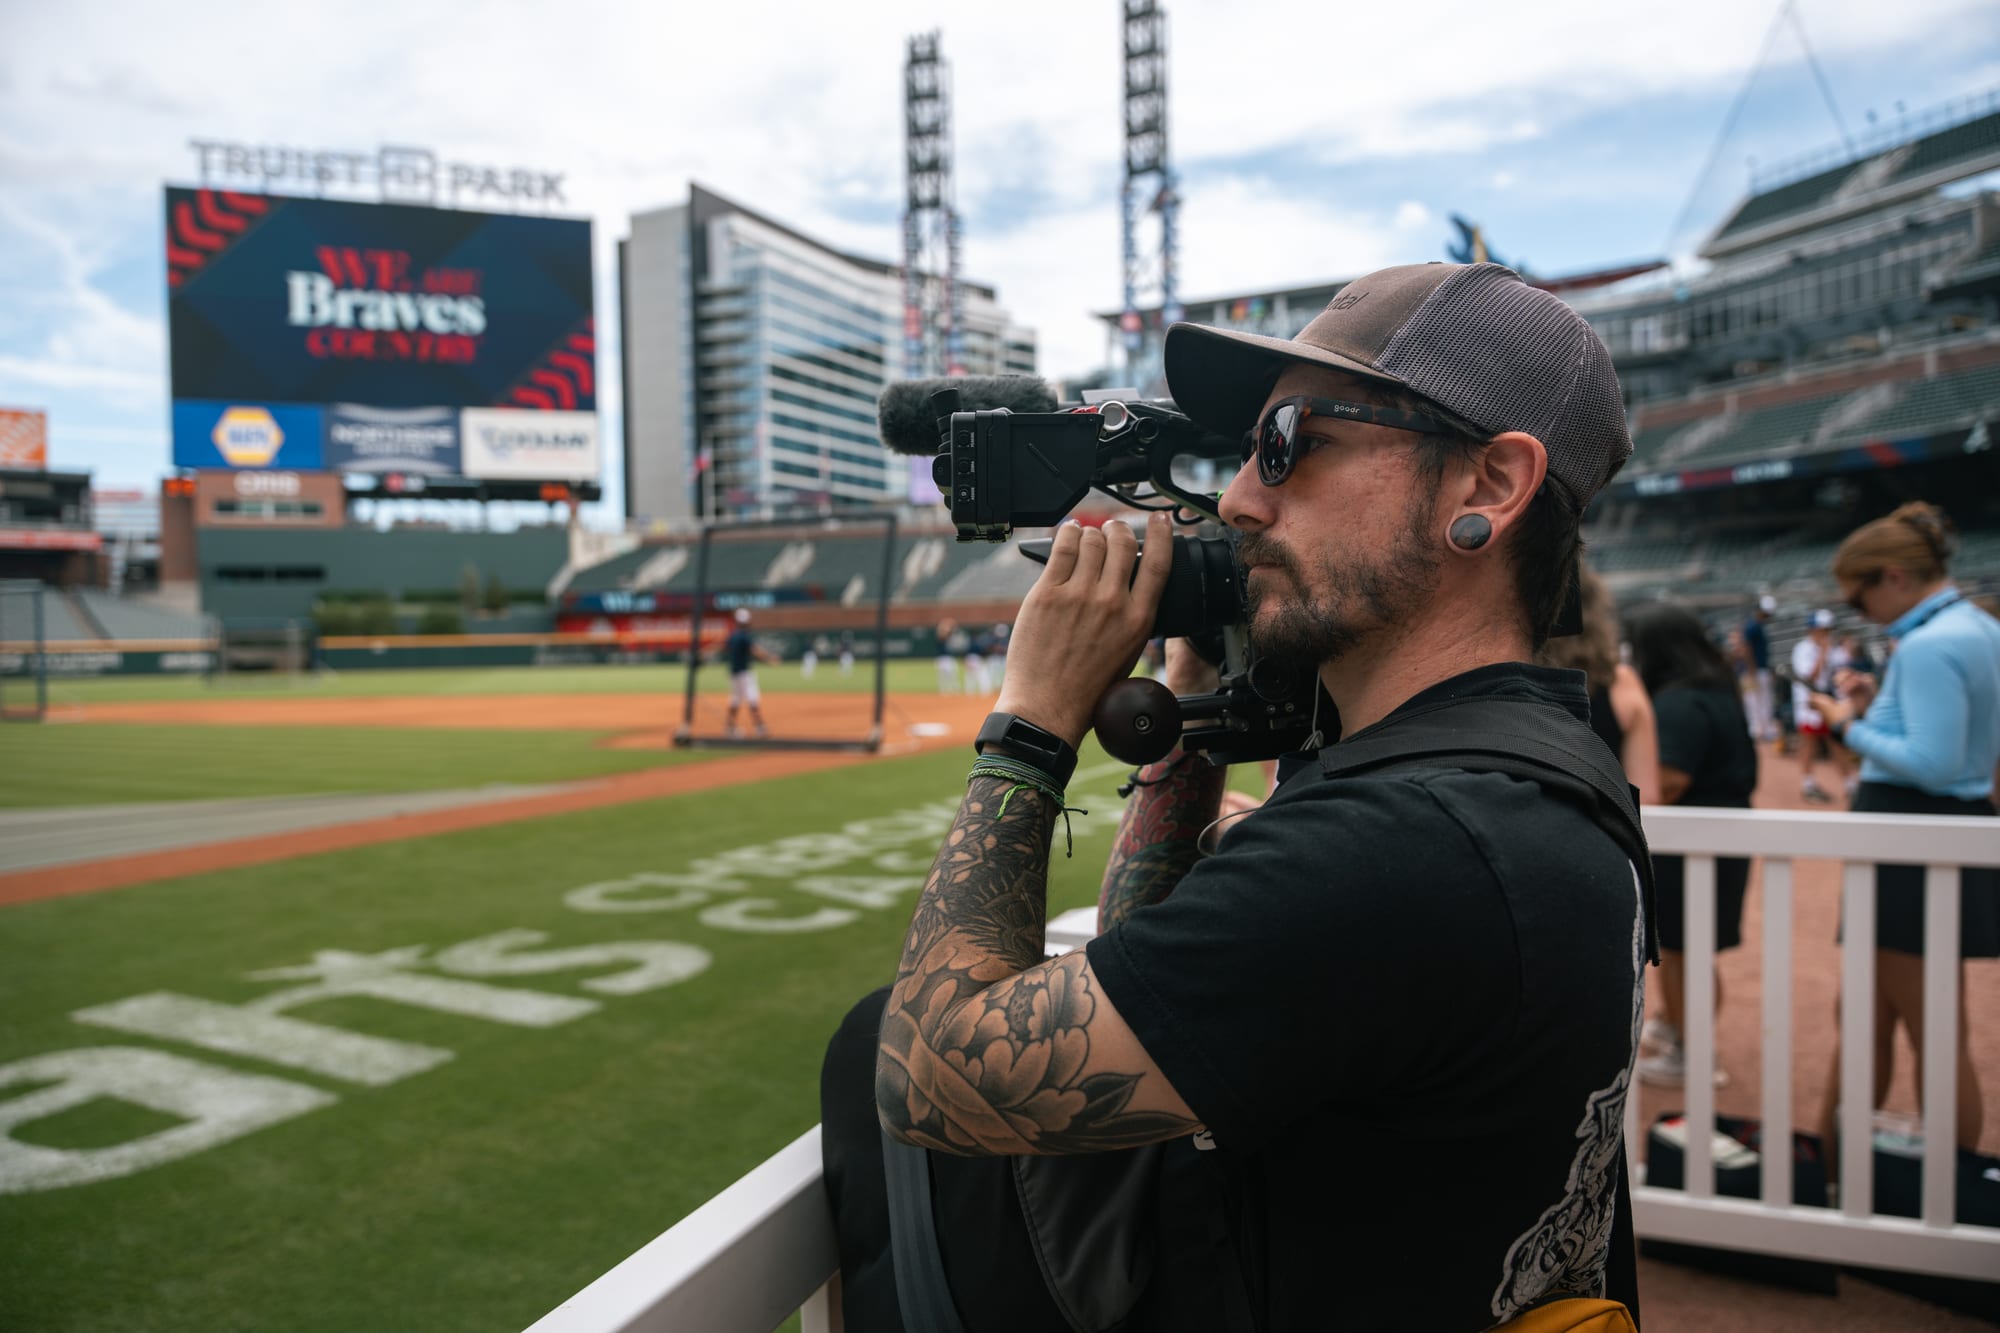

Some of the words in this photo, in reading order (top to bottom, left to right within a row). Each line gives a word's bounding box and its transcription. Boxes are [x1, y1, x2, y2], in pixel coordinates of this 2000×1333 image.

[189, 140, 373, 184] TRUIST
[449, 163, 569, 203] PARK
[286, 269, 487, 336] Braves
[1334, 404, 1361, 413] goodr
